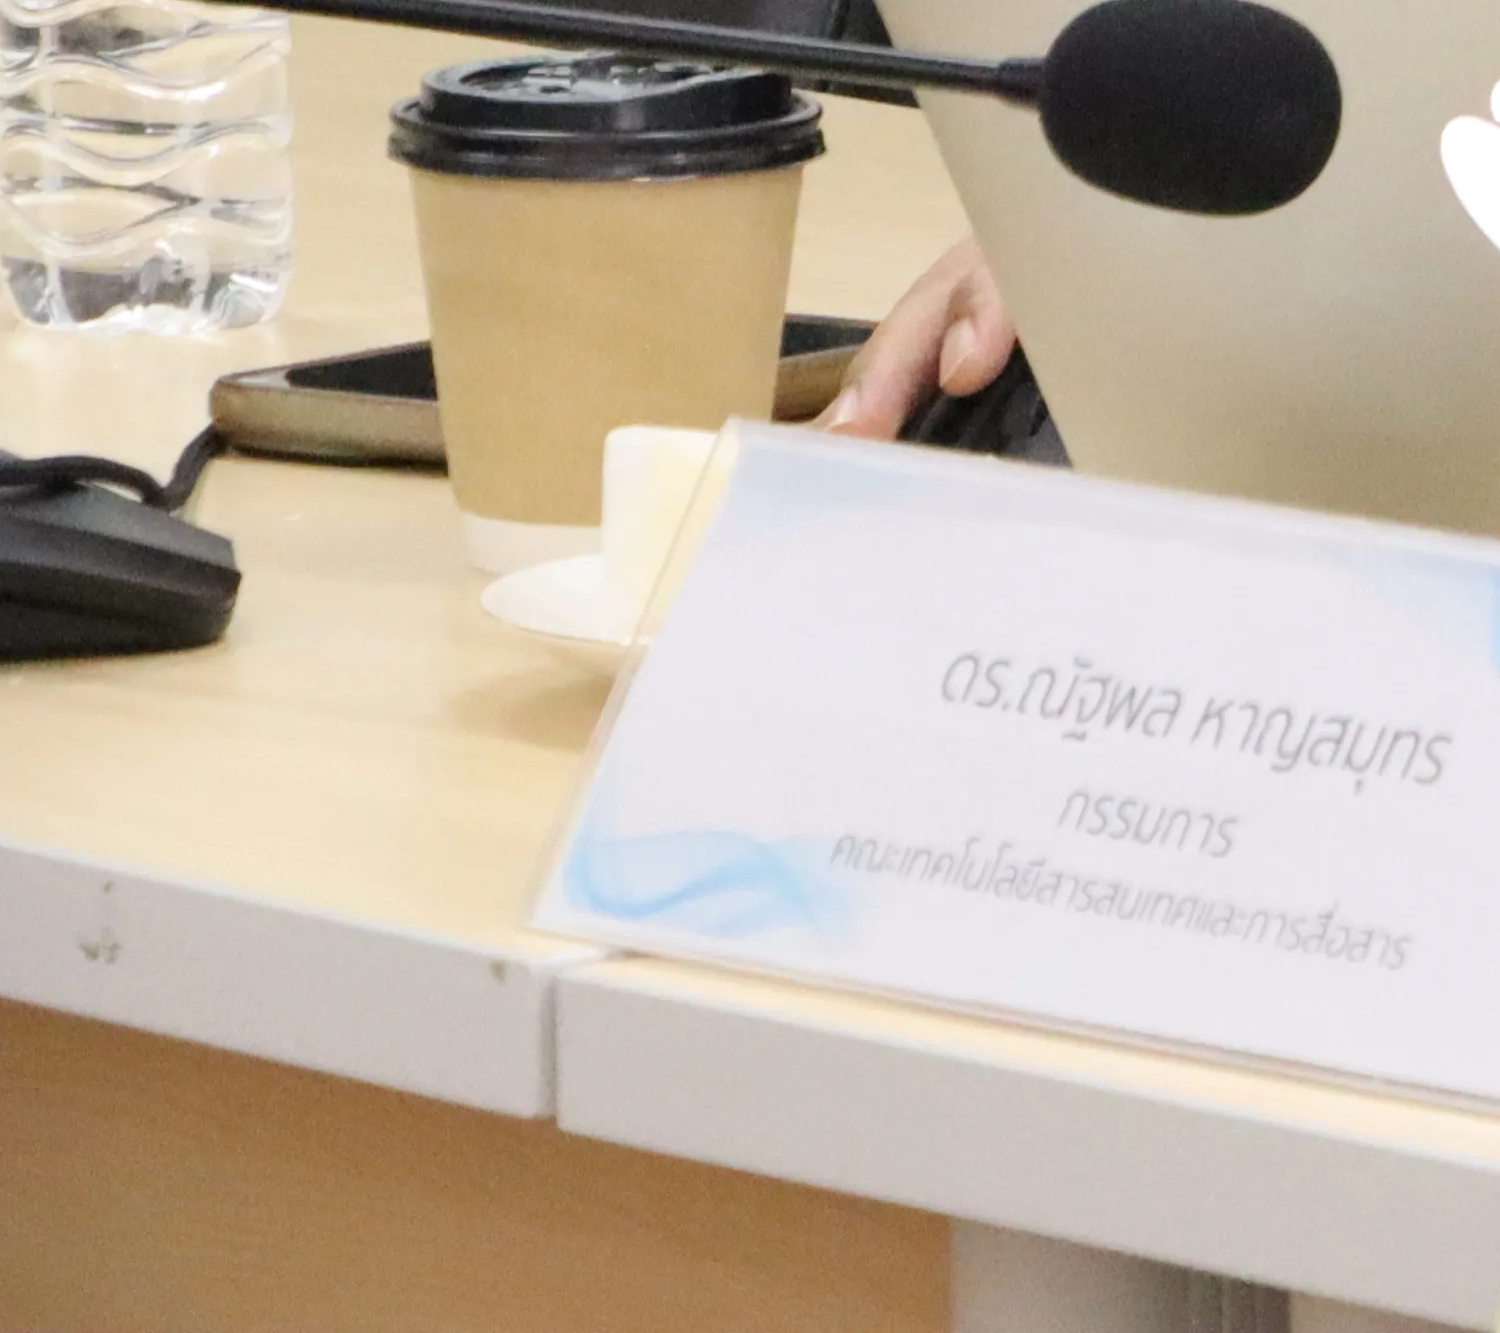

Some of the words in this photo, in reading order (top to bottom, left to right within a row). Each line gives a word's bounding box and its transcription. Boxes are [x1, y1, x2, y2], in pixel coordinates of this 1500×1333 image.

[940, 651, 1185, 742] ดร.ณัฐพล
[1189, 696, 1455, 795] หาญสมุทร
[1057, 789, 1241, 859] กรรมการ
[828, 831, 1414, 971] คณะเทคโนโลยีสารสนเทศและการสื่อสาร
